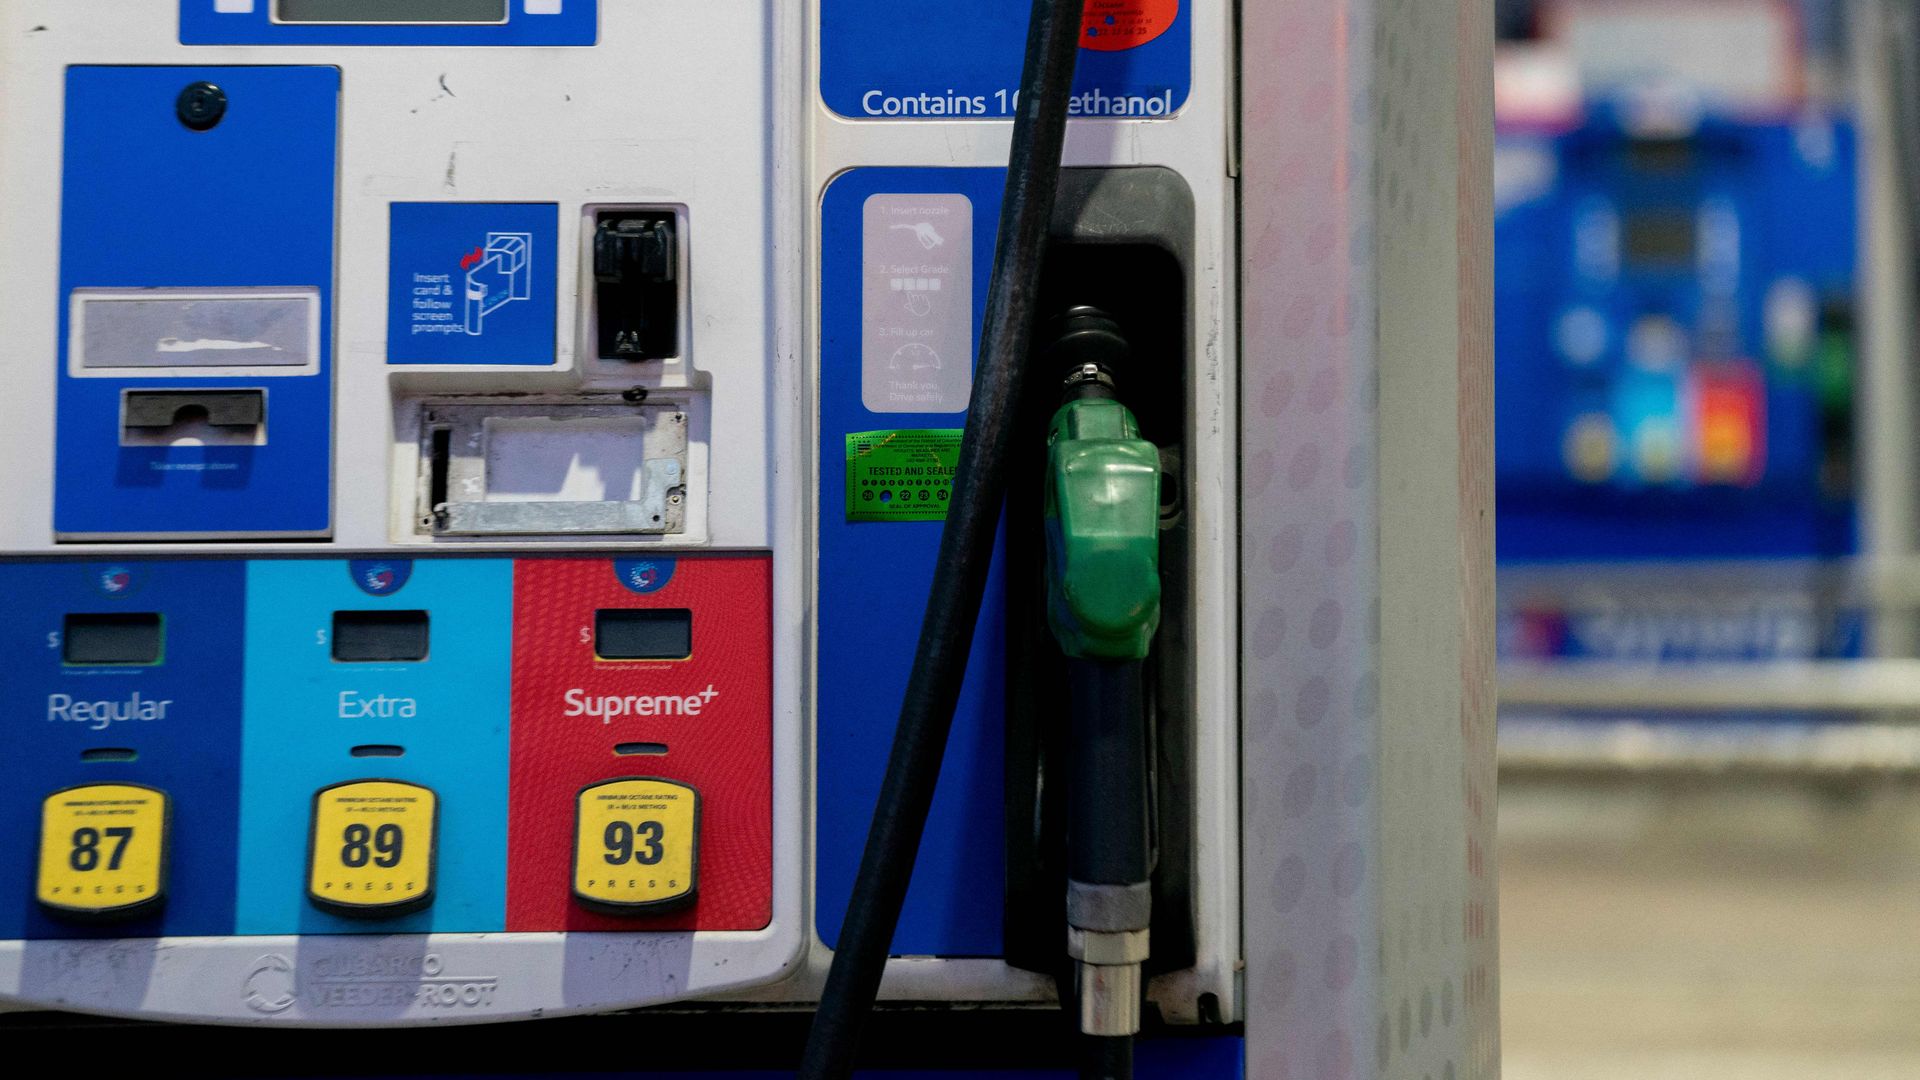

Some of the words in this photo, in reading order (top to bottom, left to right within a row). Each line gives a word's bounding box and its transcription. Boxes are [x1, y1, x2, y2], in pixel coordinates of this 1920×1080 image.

[862, 89, 986, 116] Contains
[1067, 88, 1172, 116] ethanol
[891, 265, 918, 274] Select
[920, 265, 950, 274] Grade
[413, 273, 450, 283] Insert
[412, 285, 440, 295] card
[442, 285, 453, 295] &
[412, 298, 452, 309] follow
[412, 311, 453, 321] screen
[411, 323, 465, 335] prompts
[869, 466, 902, 476] TESTED
[905, 466, 924, 476] AND
[579, 626, 591, 644] $
[338, 690, 417, 718] Extra
[47, 691, 174, 730] Regular
[341, 823, 403, 868] 89
[603, 820, 664, 866] 93
[69, 827, 135, 872] 87
[588, 879, 677, 888] PRESS
